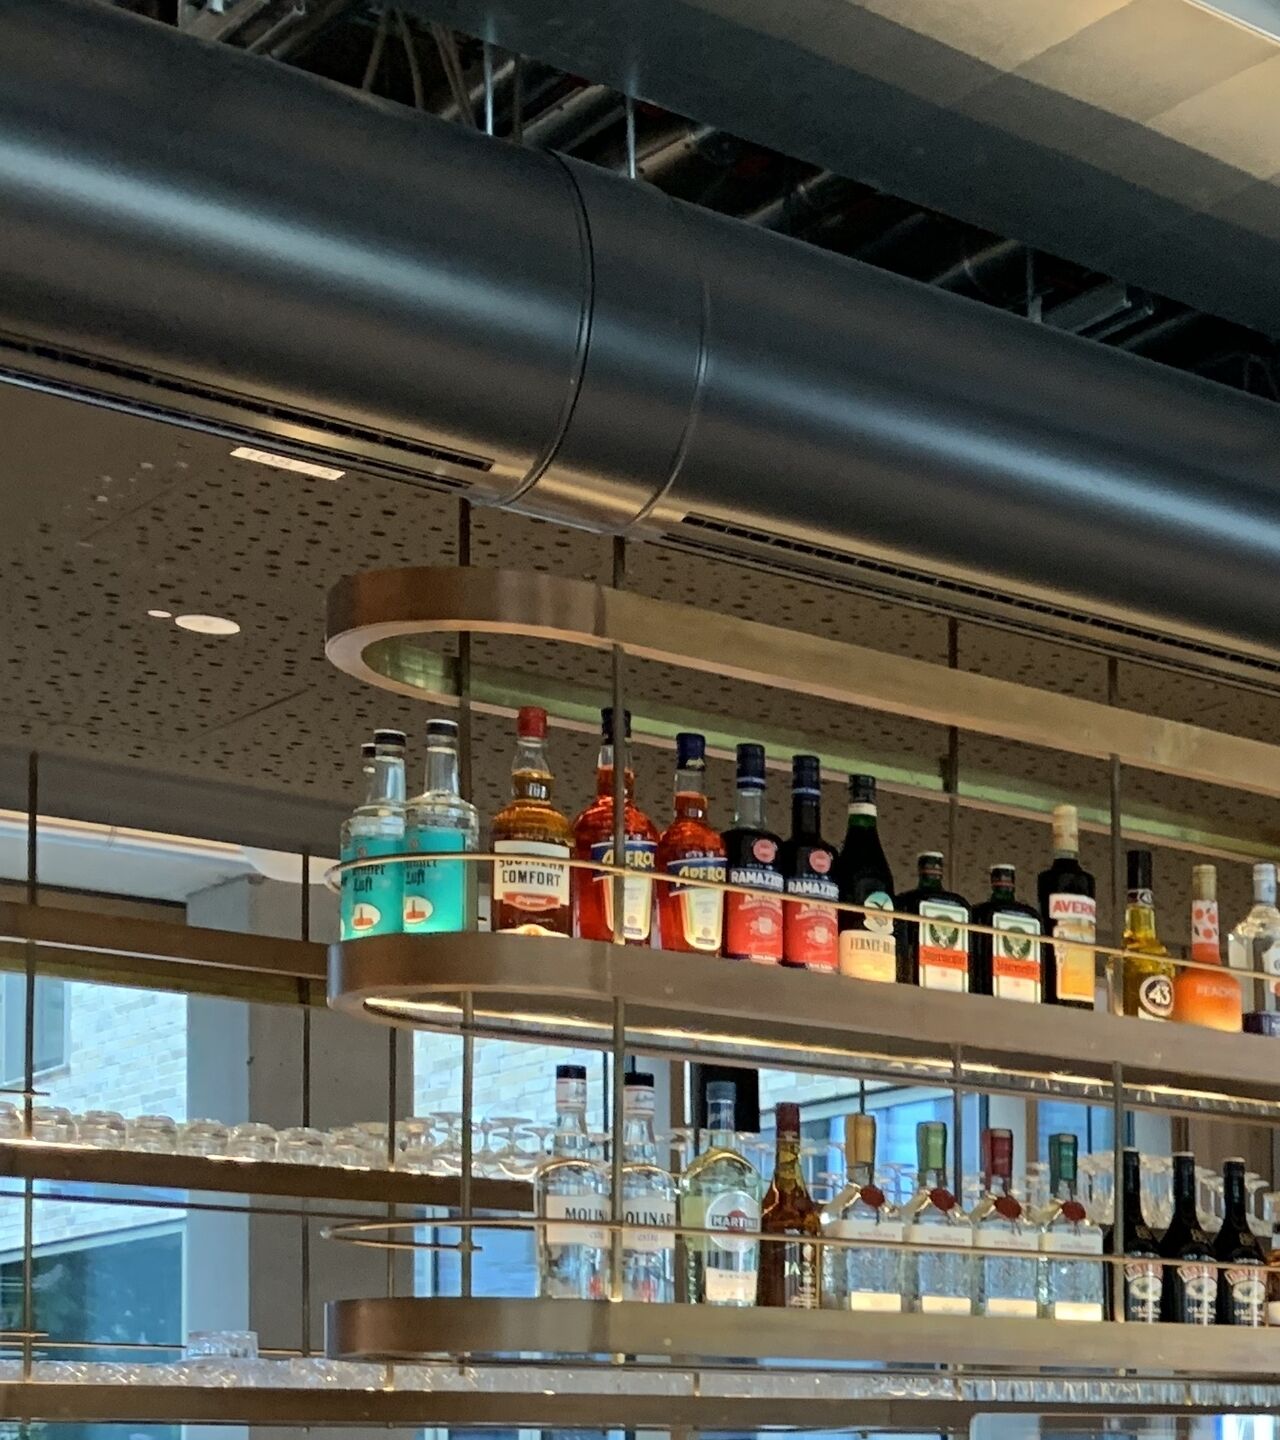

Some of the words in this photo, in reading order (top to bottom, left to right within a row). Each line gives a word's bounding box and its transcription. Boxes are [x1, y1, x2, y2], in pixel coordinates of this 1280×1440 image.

[602, 848, 656, 868] AERO
[502, 870, 561, 887] COMFORT
[1148, 984, 1172, 1006] 43
